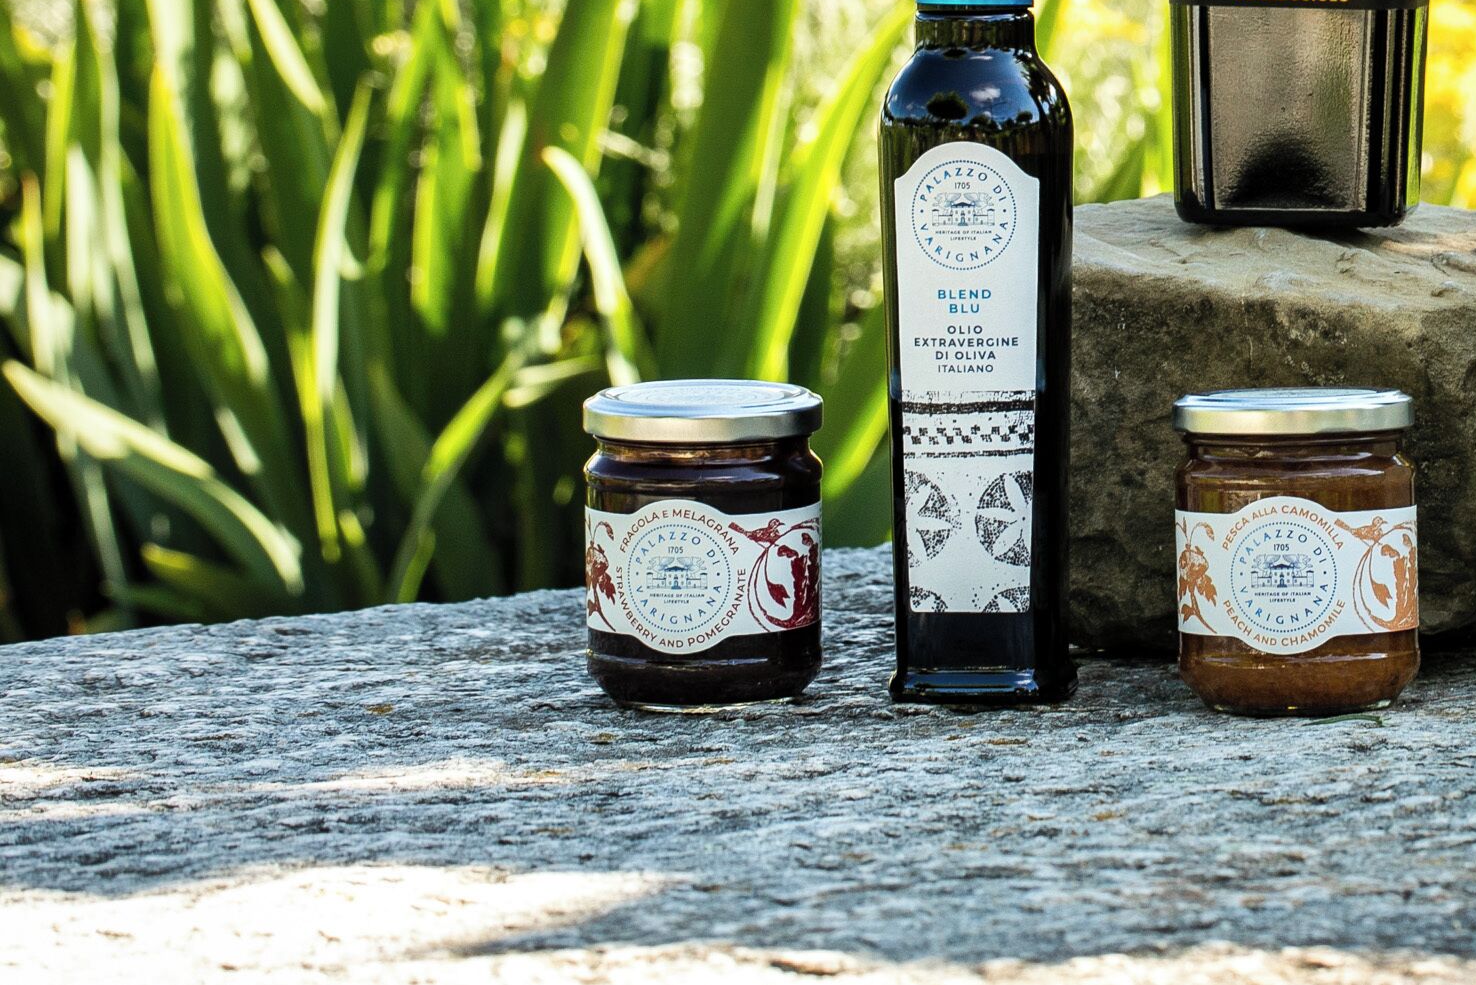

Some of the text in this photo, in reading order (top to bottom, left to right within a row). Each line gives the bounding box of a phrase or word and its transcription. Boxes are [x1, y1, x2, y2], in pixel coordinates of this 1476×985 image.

[920, 168, 1006, 202] PALAZZO DI
[954, 182, 970, 190] 1705
[920, 222, 1008, 262] VARIGNANA
[938, 290, 992, 300] BLEND
[949, 304, 980, 314] BLU
[914, 337, 1019, 347] EXTRAVERGINE
[947, 325, 982, 334] OLIO
[936, 350, 996, 360] DI OLIVA
[938, 364, 994, 373] ITALIANO
[620, 508, 740, 556] FRAGOLA E MELAGRANA
[1222, 505, 1344, 552] PESCA ALLA CAMOMILLA
[636, 531, 720, 565] PALAZZO DI
[668, 546, 684, 554] 1705
[1240, 529, 1327, 565] PALAZZO DI
[1274, 544, 1290, 552] 1705
[616, 566, 746, 648] STRAWBERRY AND POMEGRANATE
[636, 585, 722, 624] VARIGNANA
[1240, 583, 1328, 624] VARIGNANA
[1223, 599, 1346, 647] PEACH AND CHAMOMILE
